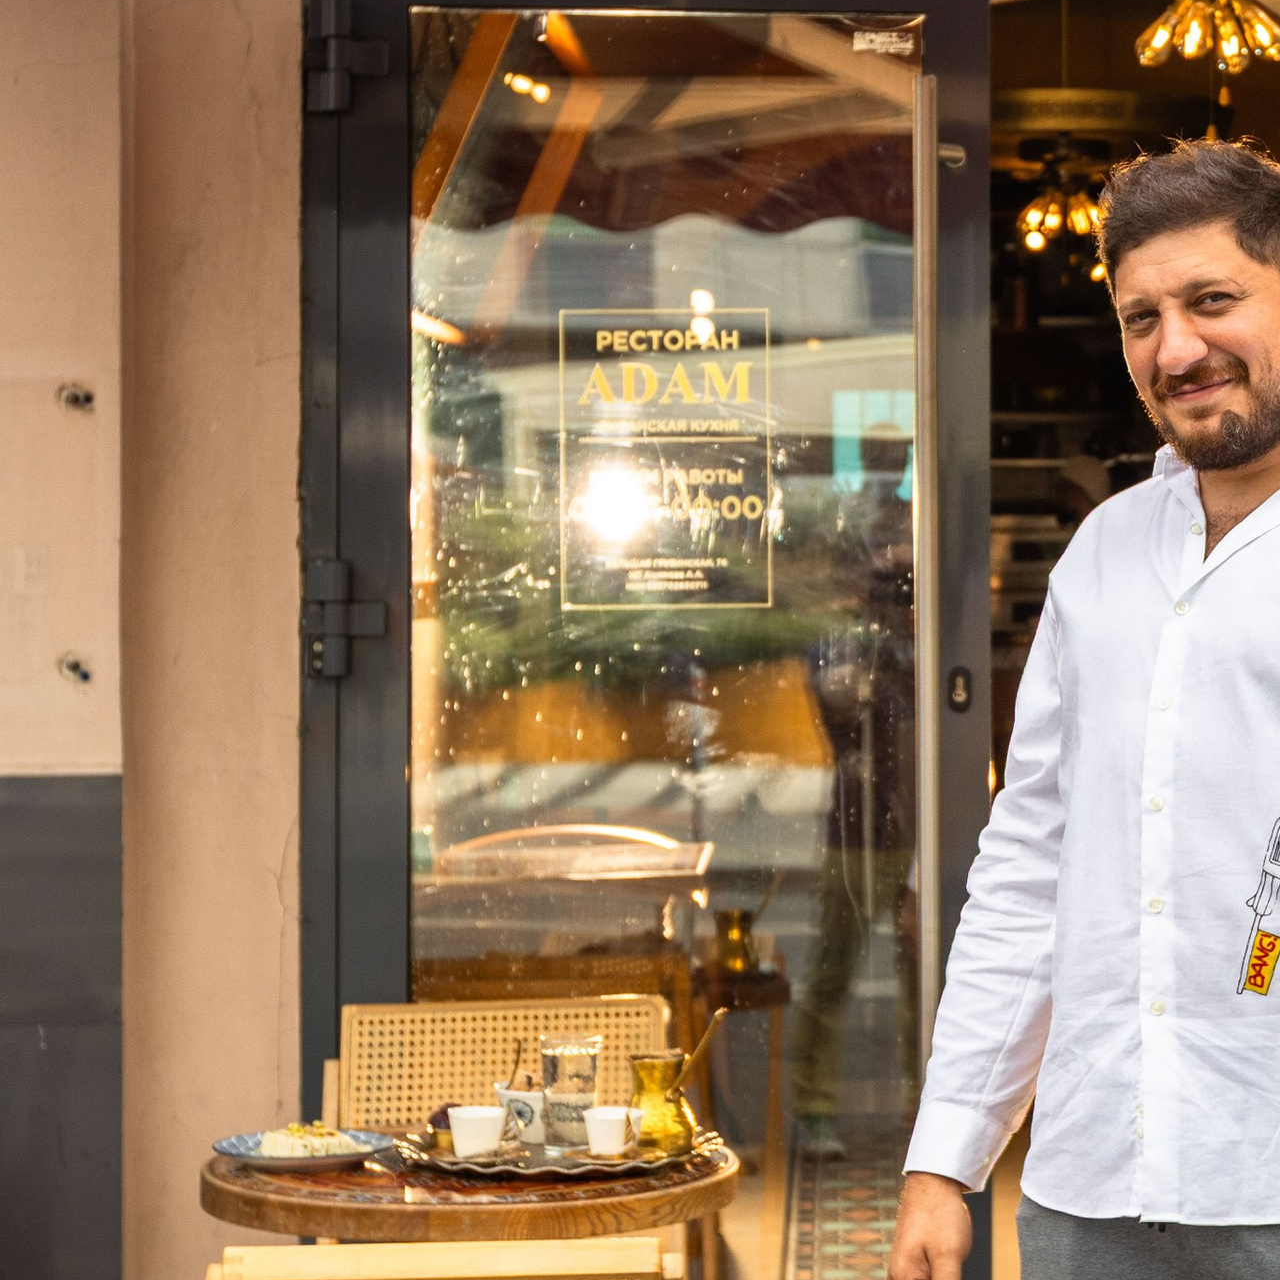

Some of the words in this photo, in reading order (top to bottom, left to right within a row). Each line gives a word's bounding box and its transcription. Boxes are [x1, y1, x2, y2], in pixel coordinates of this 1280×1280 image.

[596, 329, 740, 352] РЕСТОРАН
[577, 361, 754, 406] ADAM
[599, 419, 687, 434] АНСКАЯ
[690, 419, 740, 432] КУХНЯ
[1248, 933, 1277, 988] BANG!
